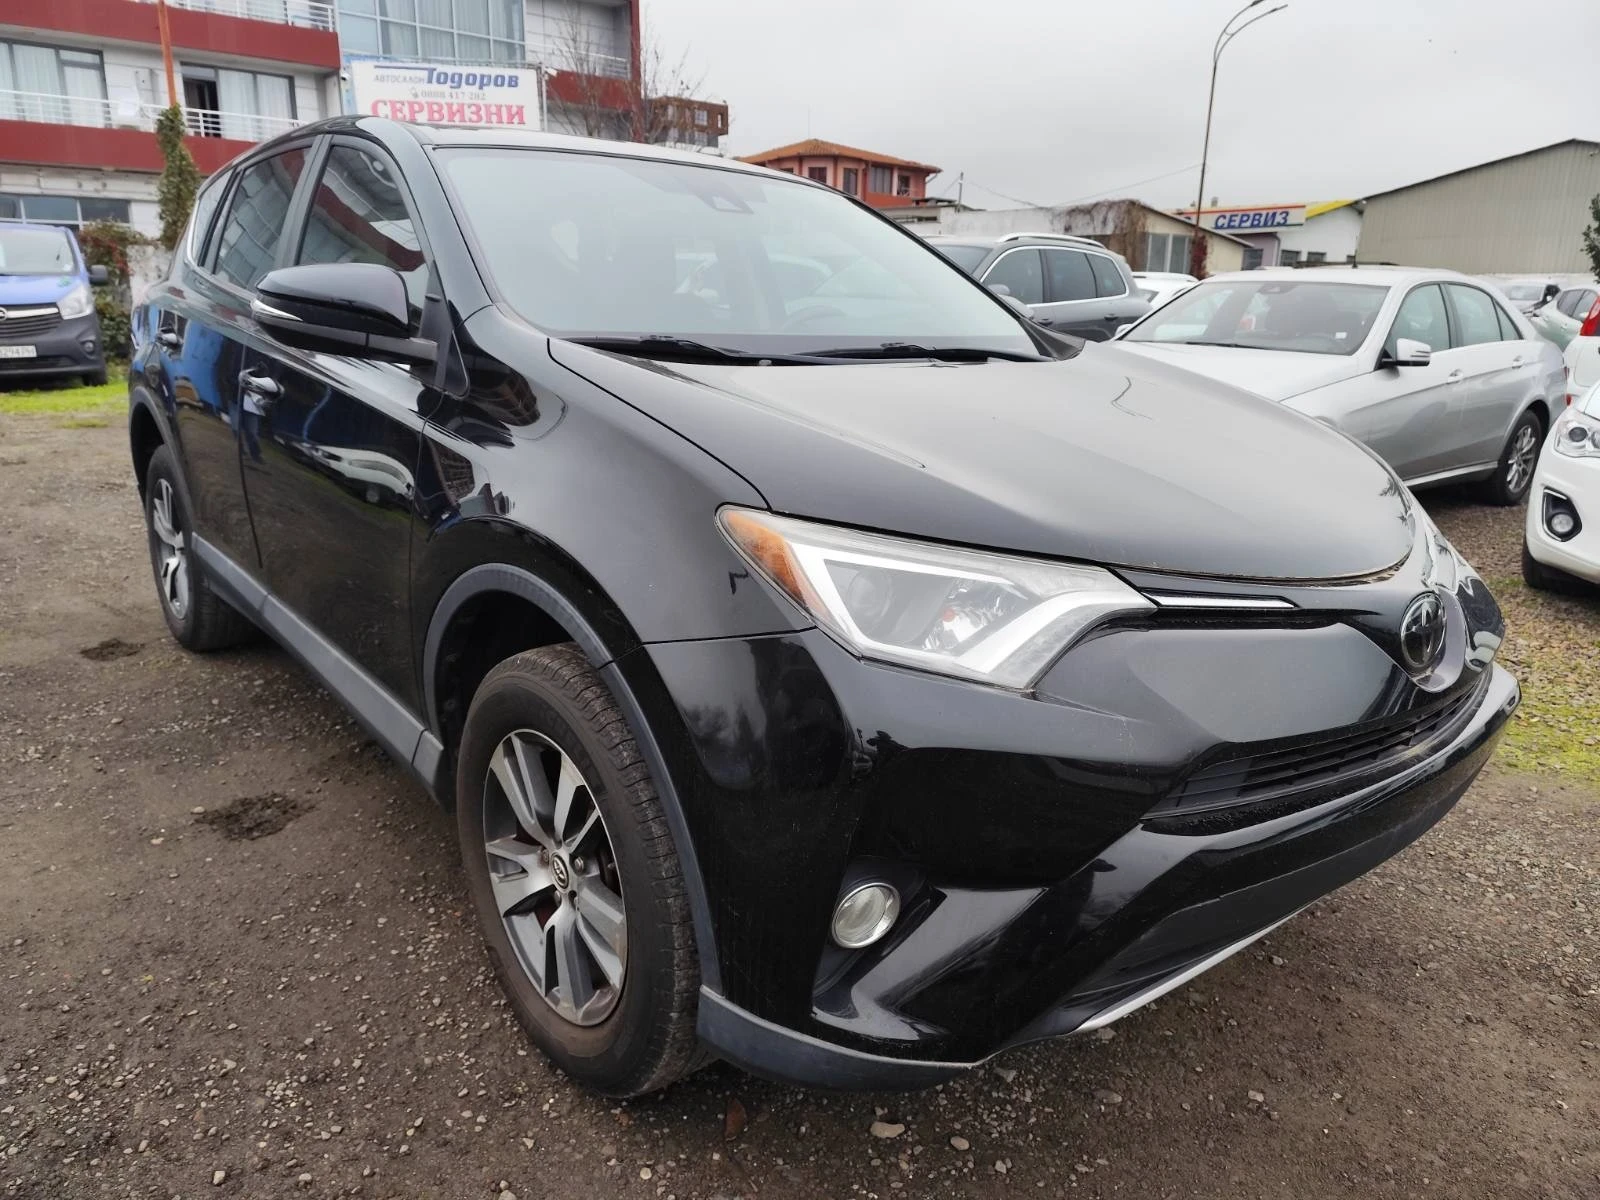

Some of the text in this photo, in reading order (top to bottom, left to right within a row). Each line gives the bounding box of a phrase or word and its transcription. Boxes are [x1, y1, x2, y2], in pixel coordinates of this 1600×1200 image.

[425, 67, 519, 90] Тодоров
[371, 100, 525, 125] СЕРВИЗНИ
[1215, 211, 1289, 229] СЕРВИЗ
